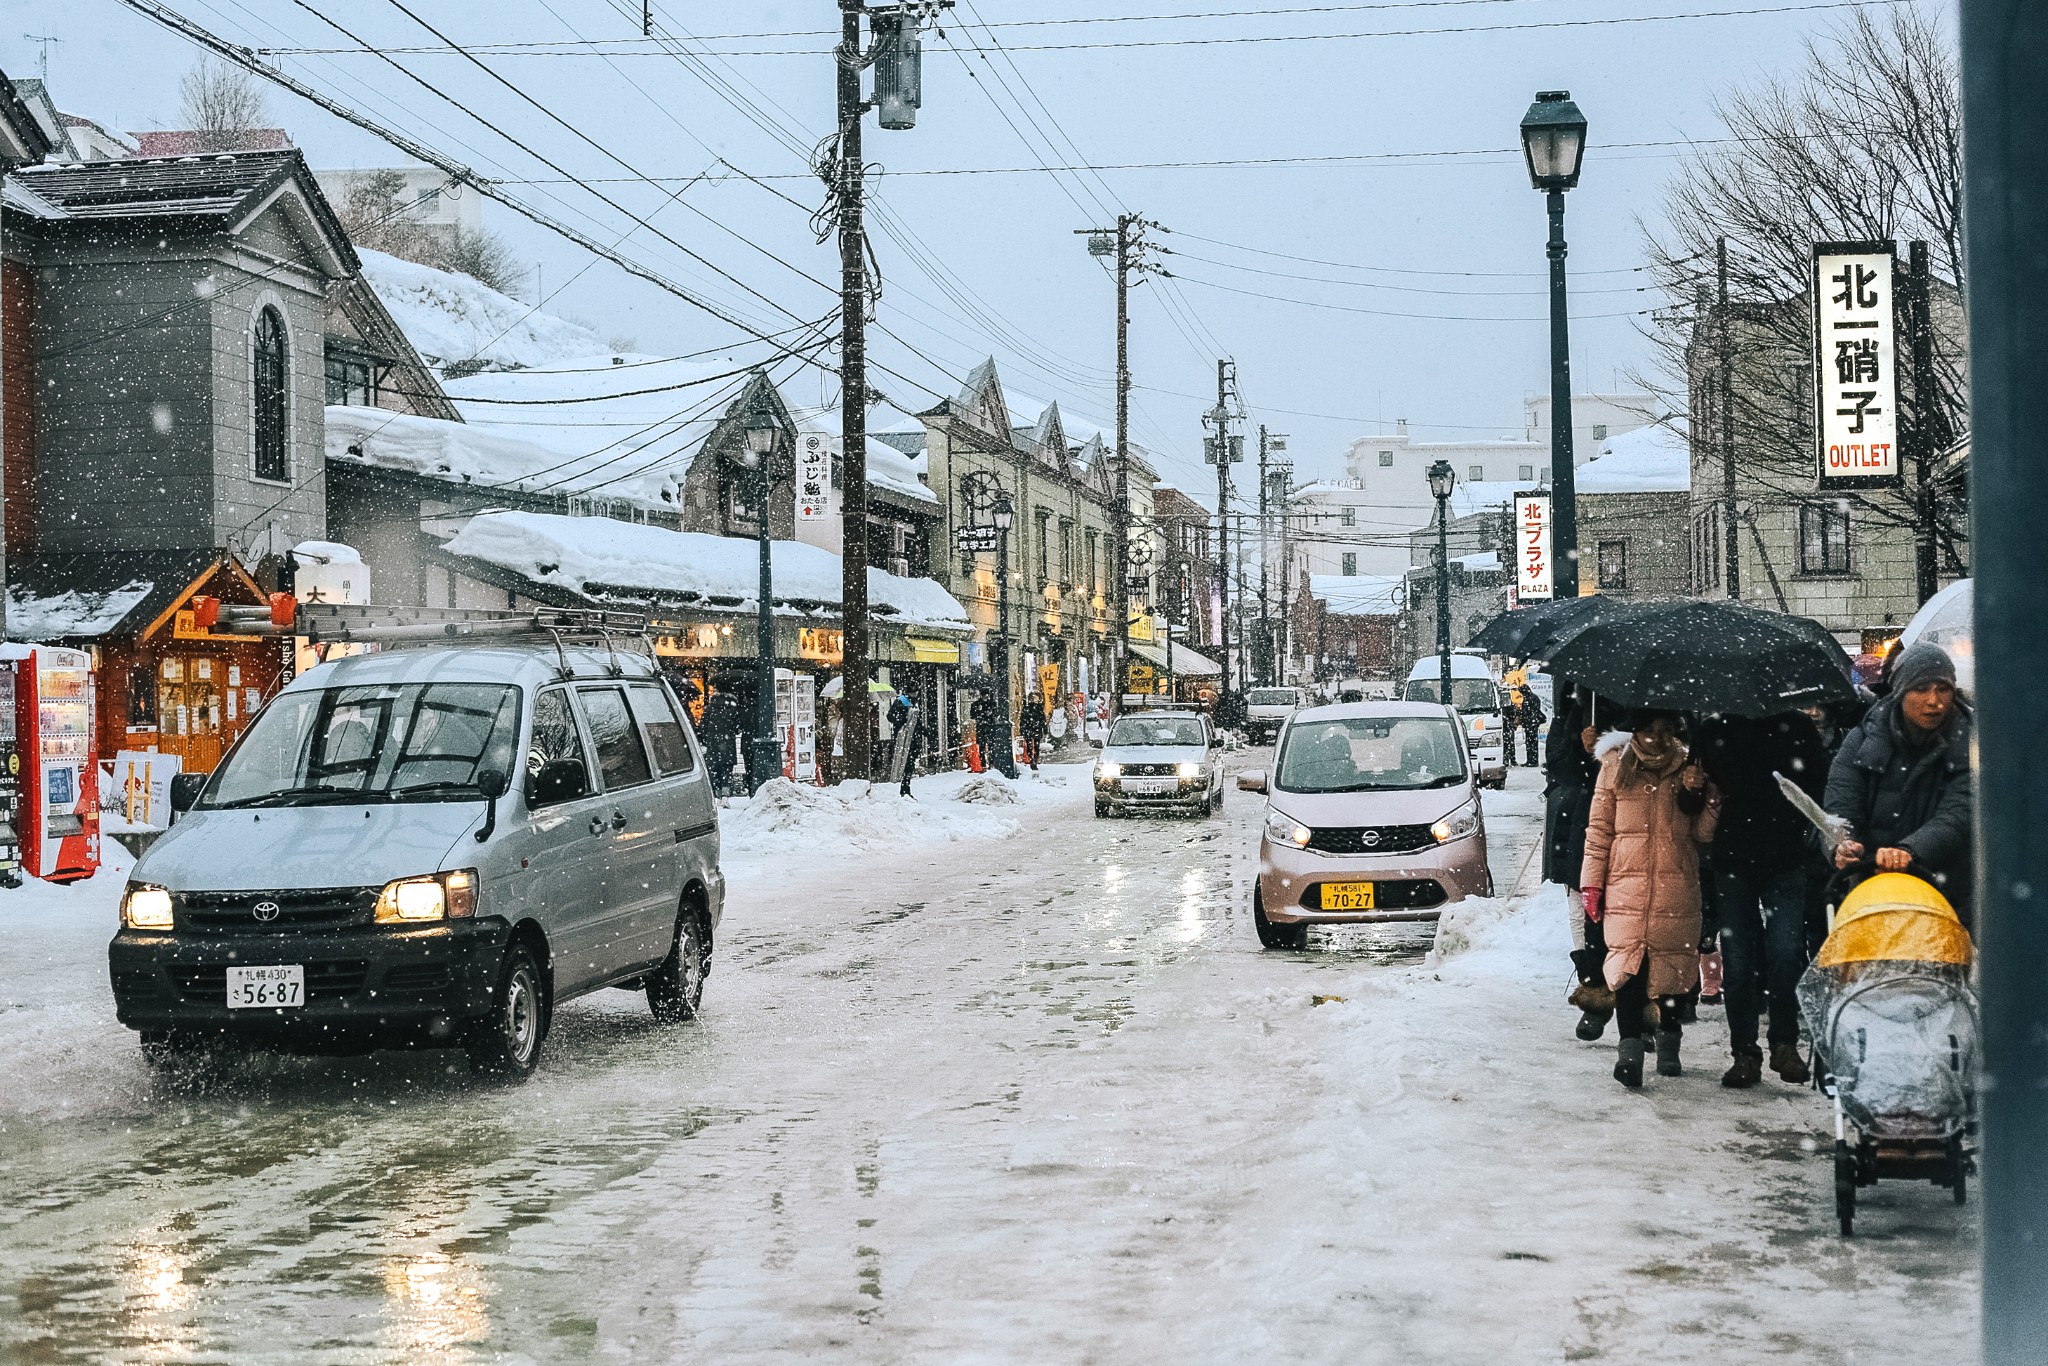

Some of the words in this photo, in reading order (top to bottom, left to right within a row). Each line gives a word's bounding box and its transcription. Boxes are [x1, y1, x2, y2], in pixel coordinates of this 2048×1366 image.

[1832, 263, 1882, 434] 北一硝子
[1829, 443, 1891, 468] OUTLET
[1524, 503, 1545, 580] 北一プラザ
[1521, 584, 1549, 594] PLAZA
[1332, 893, 1371, 908] 70-27
[243, 982, 300, 1005] 56-87
